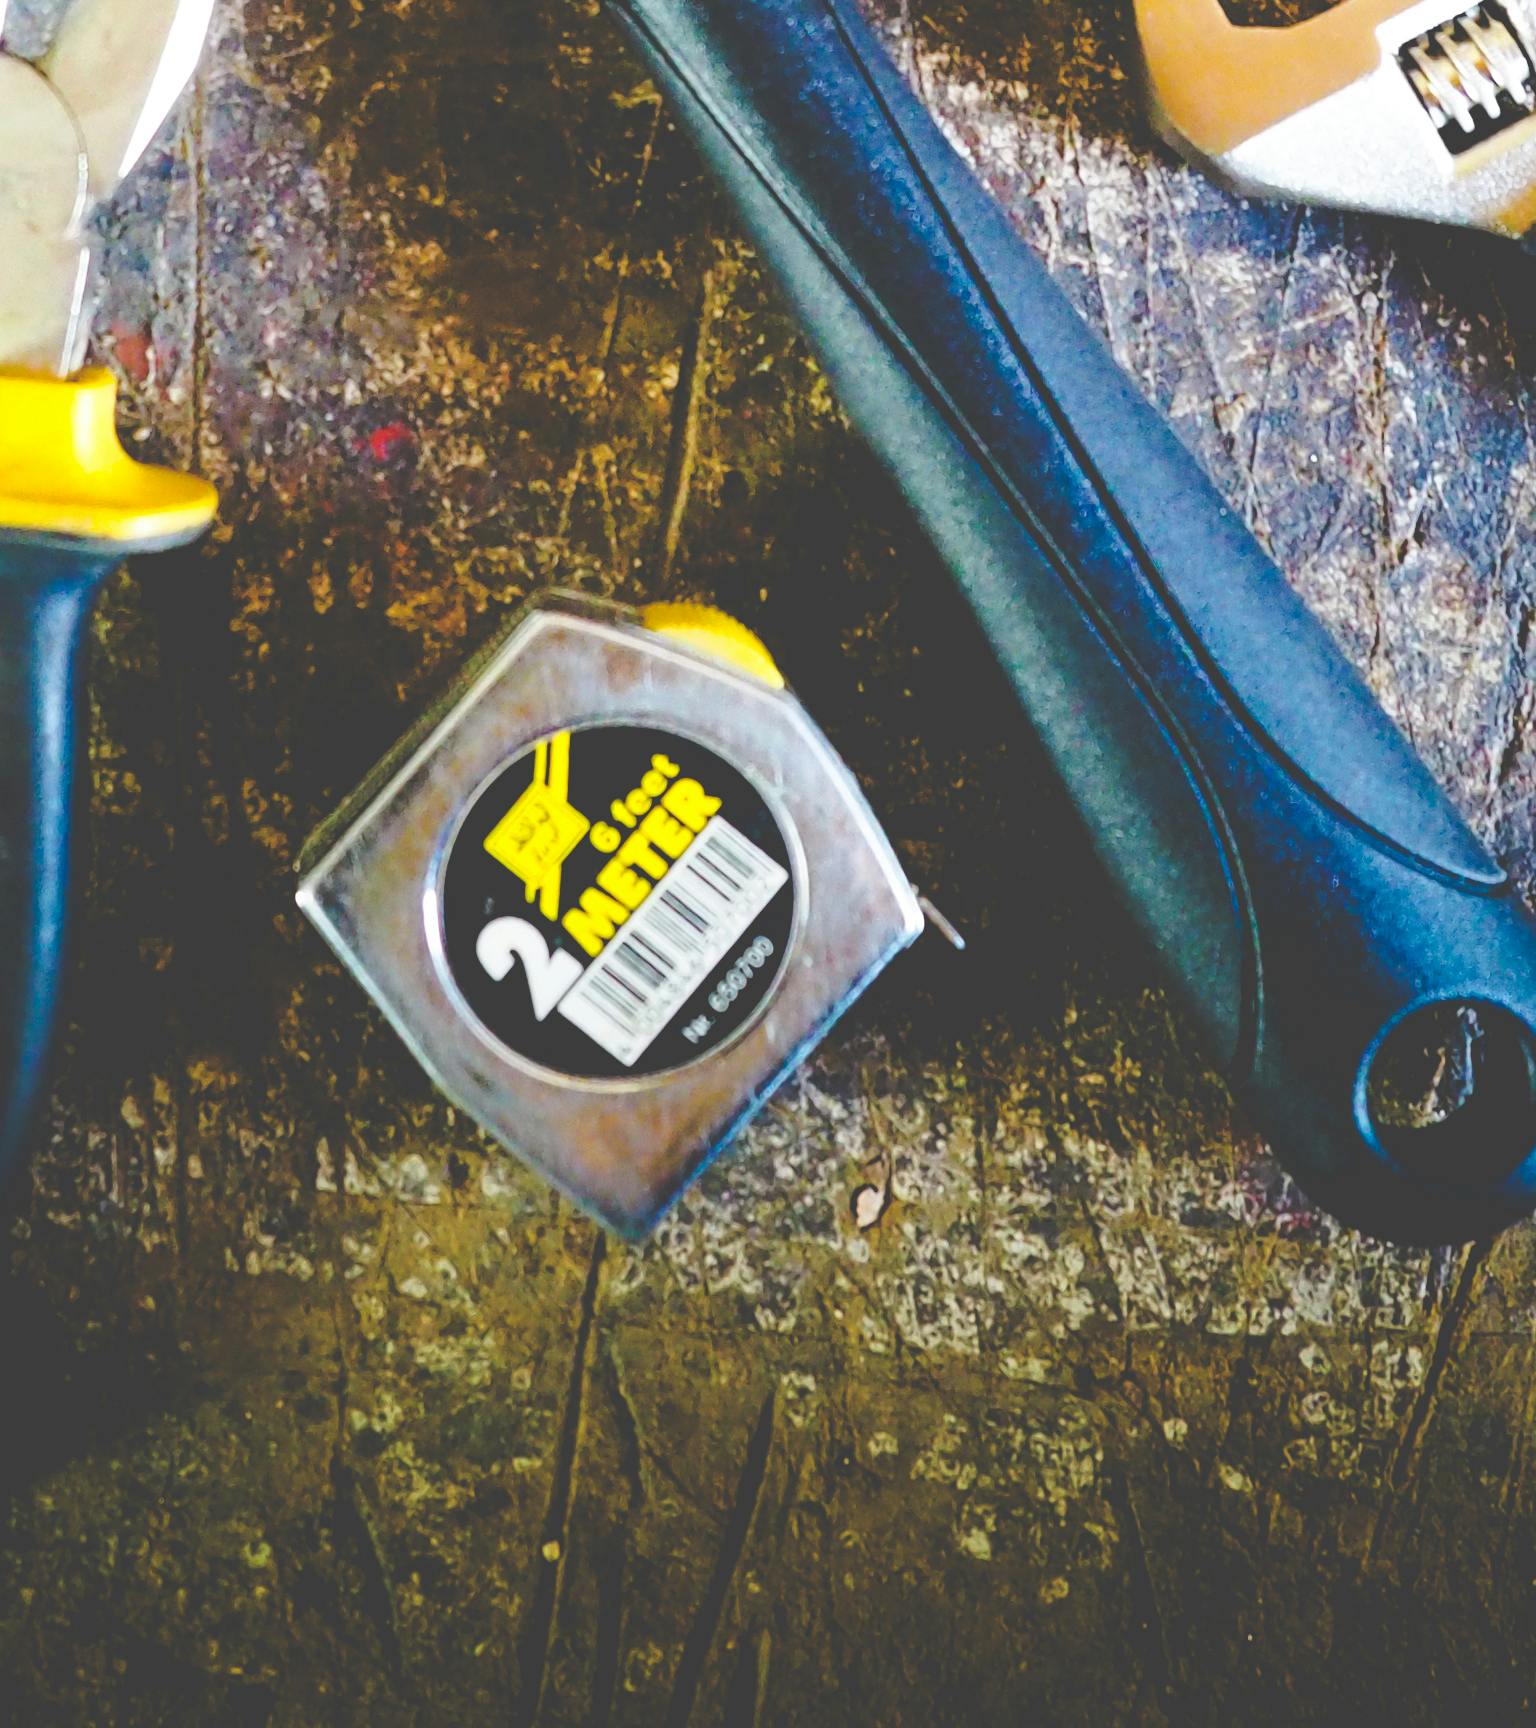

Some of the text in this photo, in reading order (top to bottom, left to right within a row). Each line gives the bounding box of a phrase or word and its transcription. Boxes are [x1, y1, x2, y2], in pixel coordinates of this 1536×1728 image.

[590, 754, 680, 853] 6 feet
[477, 917, 589, 1021] 2
[562, 778, 722, 959] METER
[708, 936, 774, 1012] 650700
